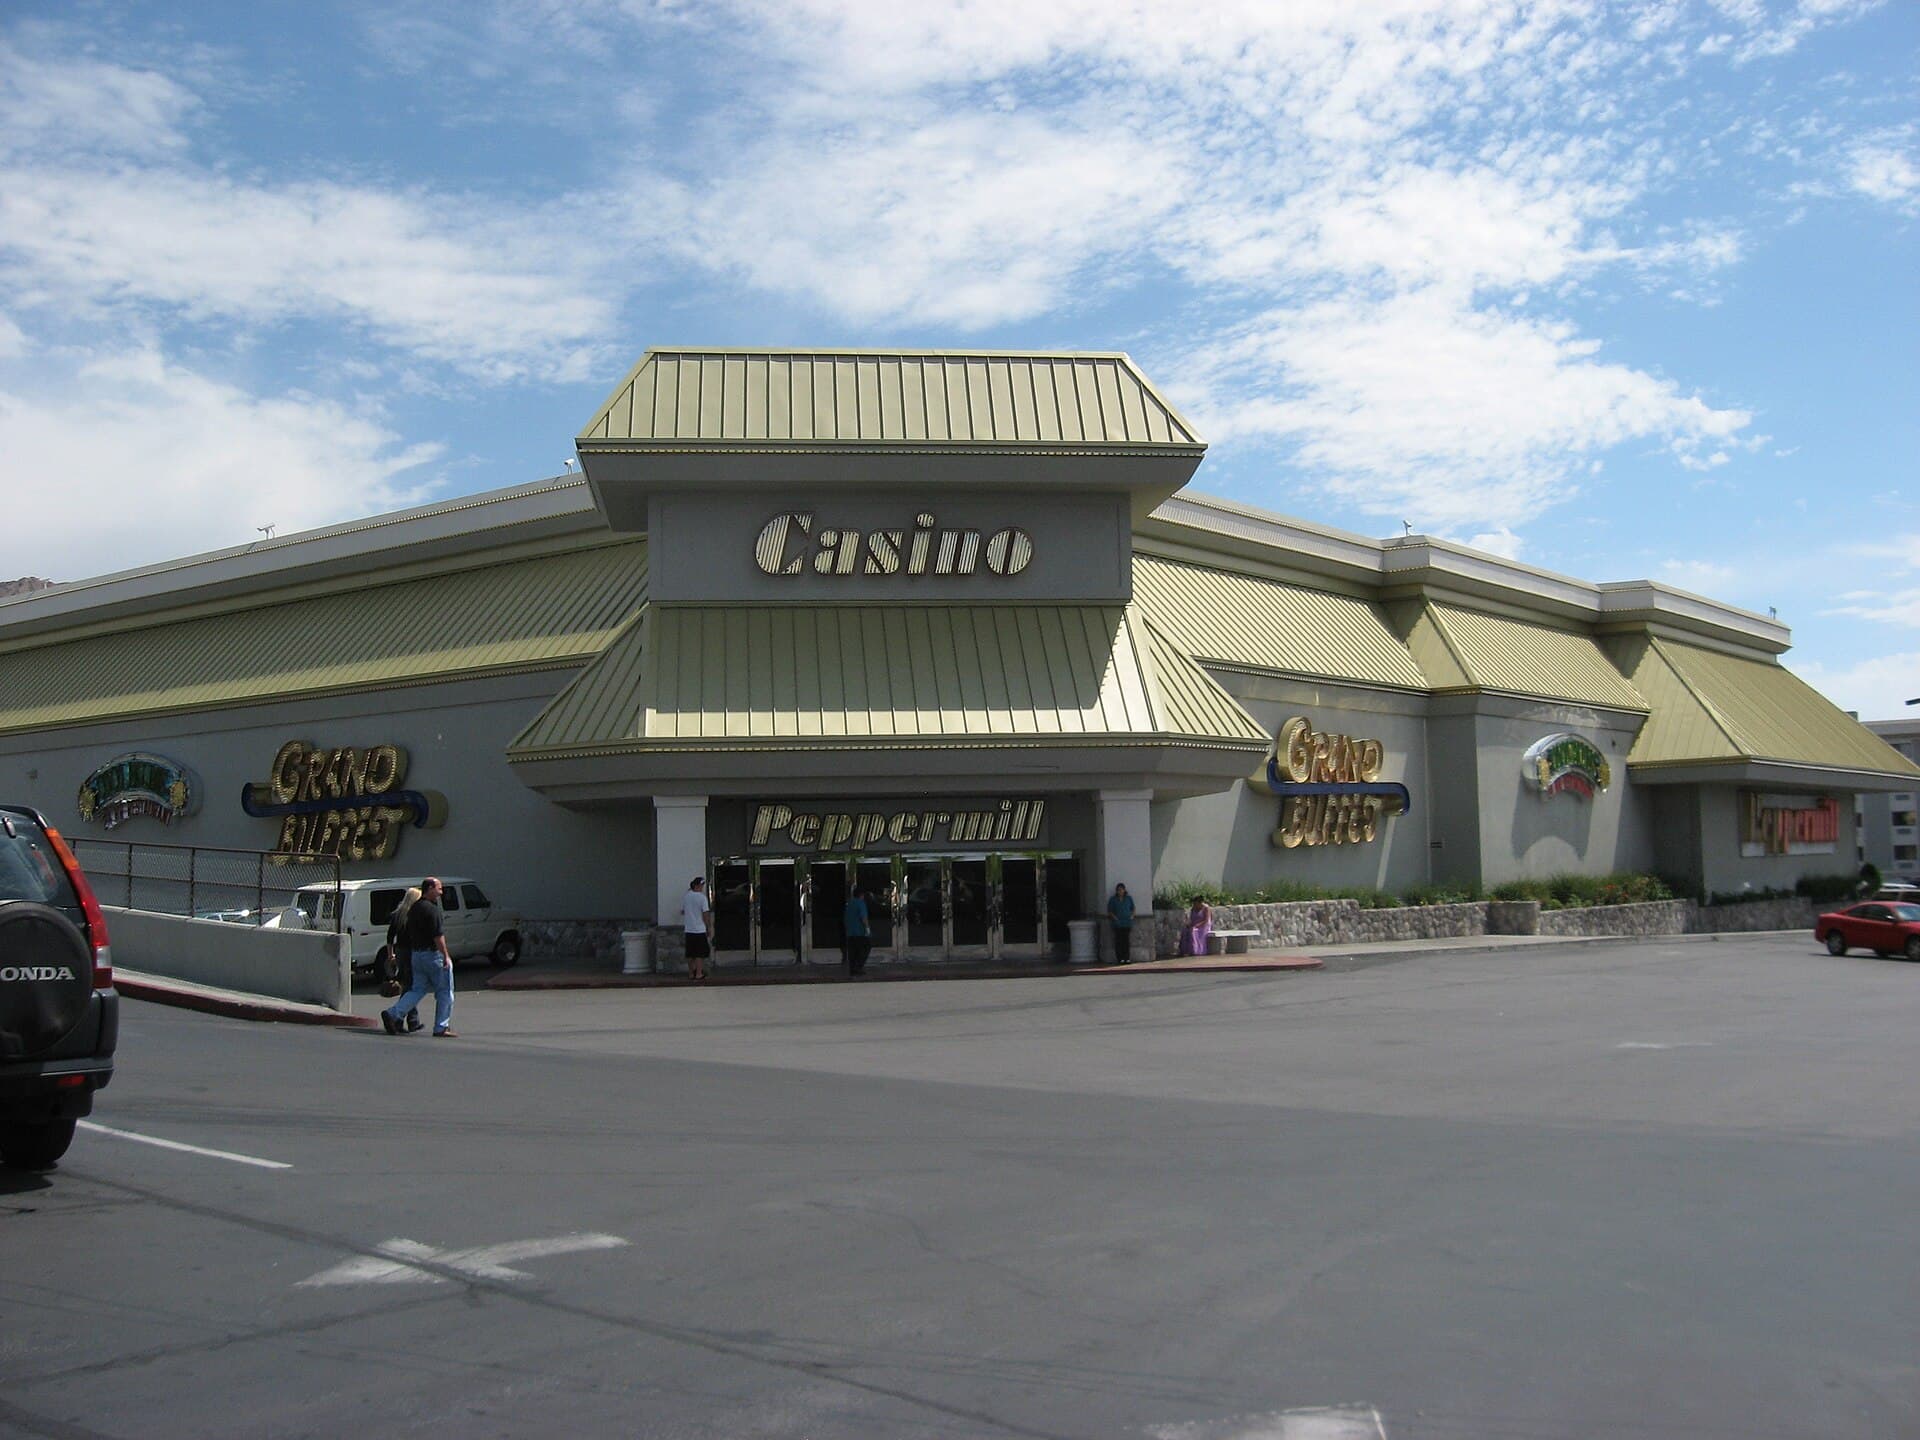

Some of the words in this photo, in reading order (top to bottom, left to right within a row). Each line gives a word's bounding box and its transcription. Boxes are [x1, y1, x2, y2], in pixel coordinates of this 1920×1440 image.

[754, 511, 1034, 576] Casino
[272, 741, 404, 804] GRAND
[1278, 717, 1384, 783] GRAND
[750, 800, 1045, 850] Peppermill
[0, 966, 76, 982] ONDA
